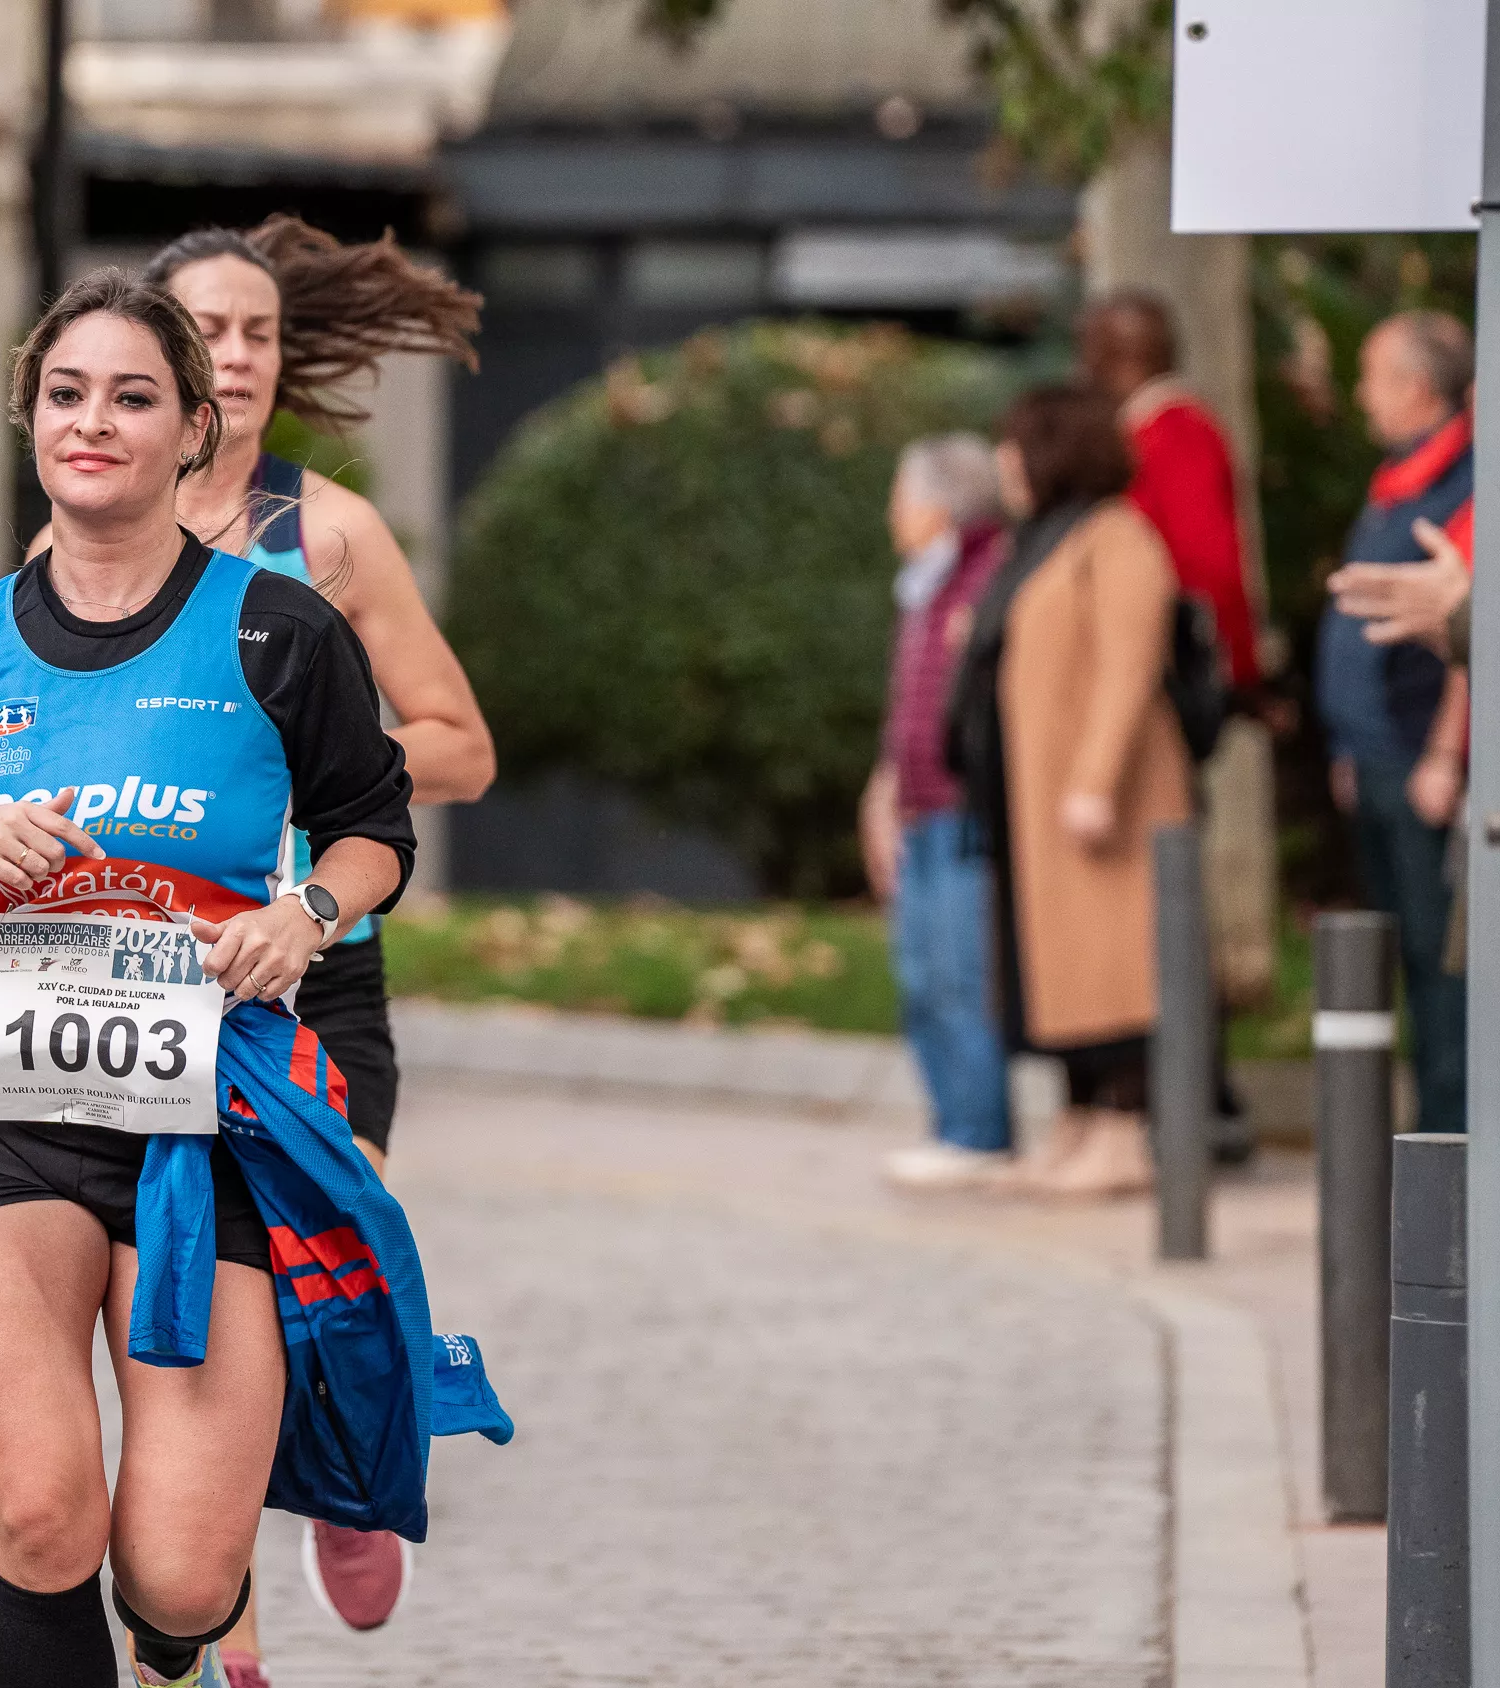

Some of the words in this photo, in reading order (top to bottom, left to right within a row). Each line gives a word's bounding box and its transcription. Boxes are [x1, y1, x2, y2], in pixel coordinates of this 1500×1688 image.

[136, 697, 219, 711] GSPORT
[84, 818, 198, 841] directo
[38, 923, 96, 936] PROVINCIAL
[99, 926, 113, 937] DE
[48, 934, 111, 948] POPULARES
[113, 926, 178, 956] 2024
[48, 946, 59, 954] DE
[64, 945, 111, 957] CÓRDOBA
[37, 982, 58, 991] XXV
[59, 983, 76, 993] C.P.
[78, 985, 113, 996] CIUDAD
[114, 989, 127, 998] DE
[129, 991, 166, 1000] LUCENA
[56, 996, 75, 1005] POR
[77, 999, 89, 1007] LA
[92, 1000, 140, 1010] IGUALDAD
[5, 1009, 188, 1081] 1003
[2, 1086, 36, 1094] MARIA
[38, 1086, 85, 1096] DOLORES
[87, 1089, 125, 1101] ROLDAN
[127, 1095, 191, 1105] BURGUILLOS
